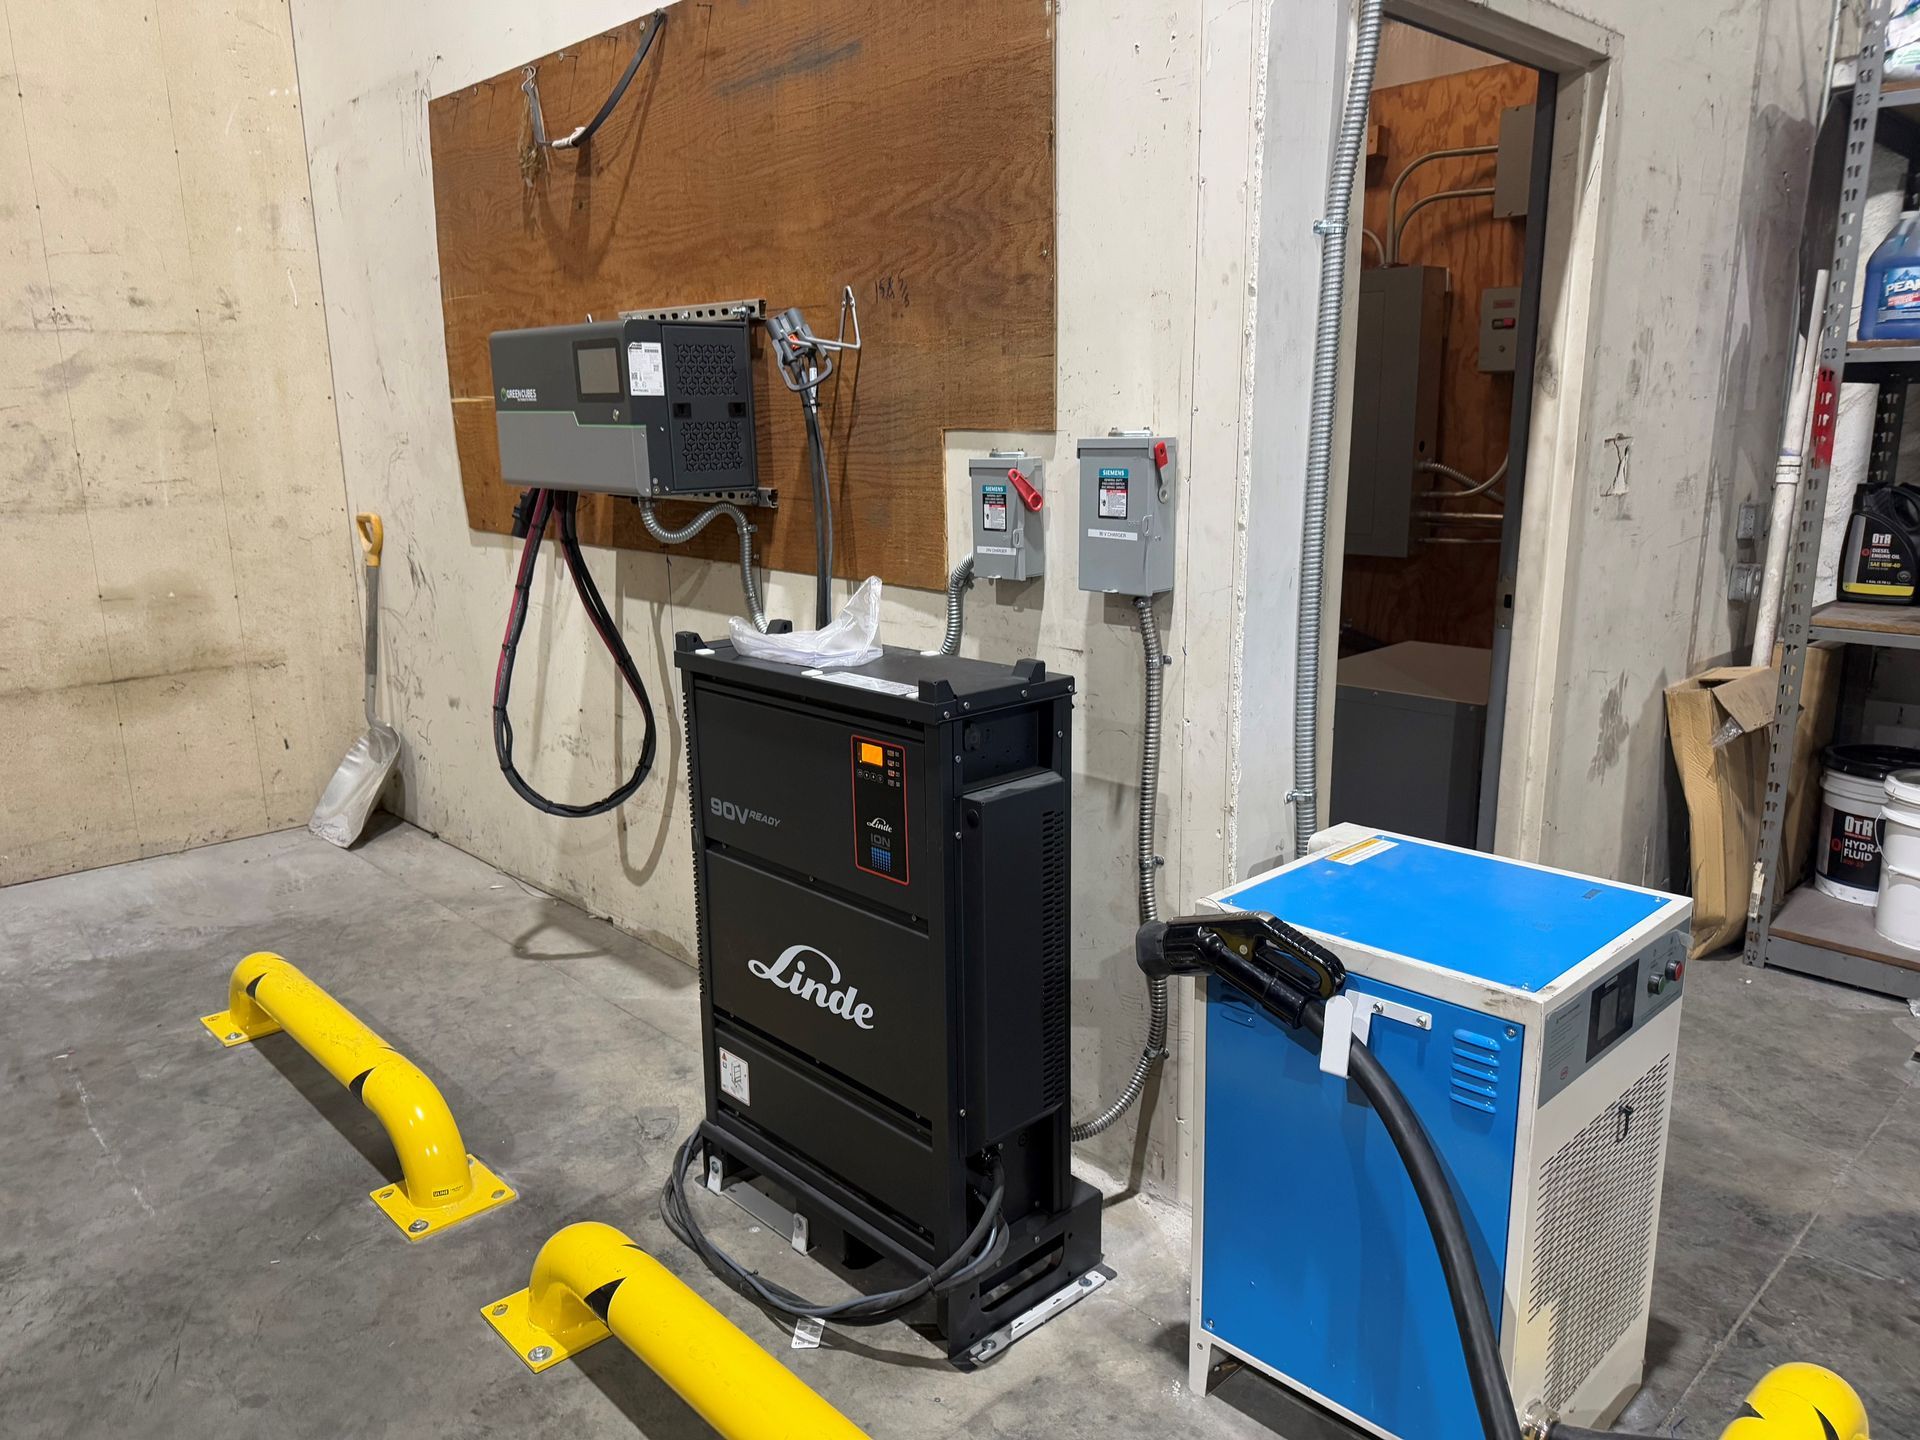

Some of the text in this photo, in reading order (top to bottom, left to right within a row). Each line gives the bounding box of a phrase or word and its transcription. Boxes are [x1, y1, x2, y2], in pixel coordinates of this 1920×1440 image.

[710, 797, 781, 827] 90V READY
[866, 817, 893, 833] Linde
[870, 832, 891, 847] ION
[1843, 847, 1873, 862] FLUID
[747, 944, 874, 1030] Linde
